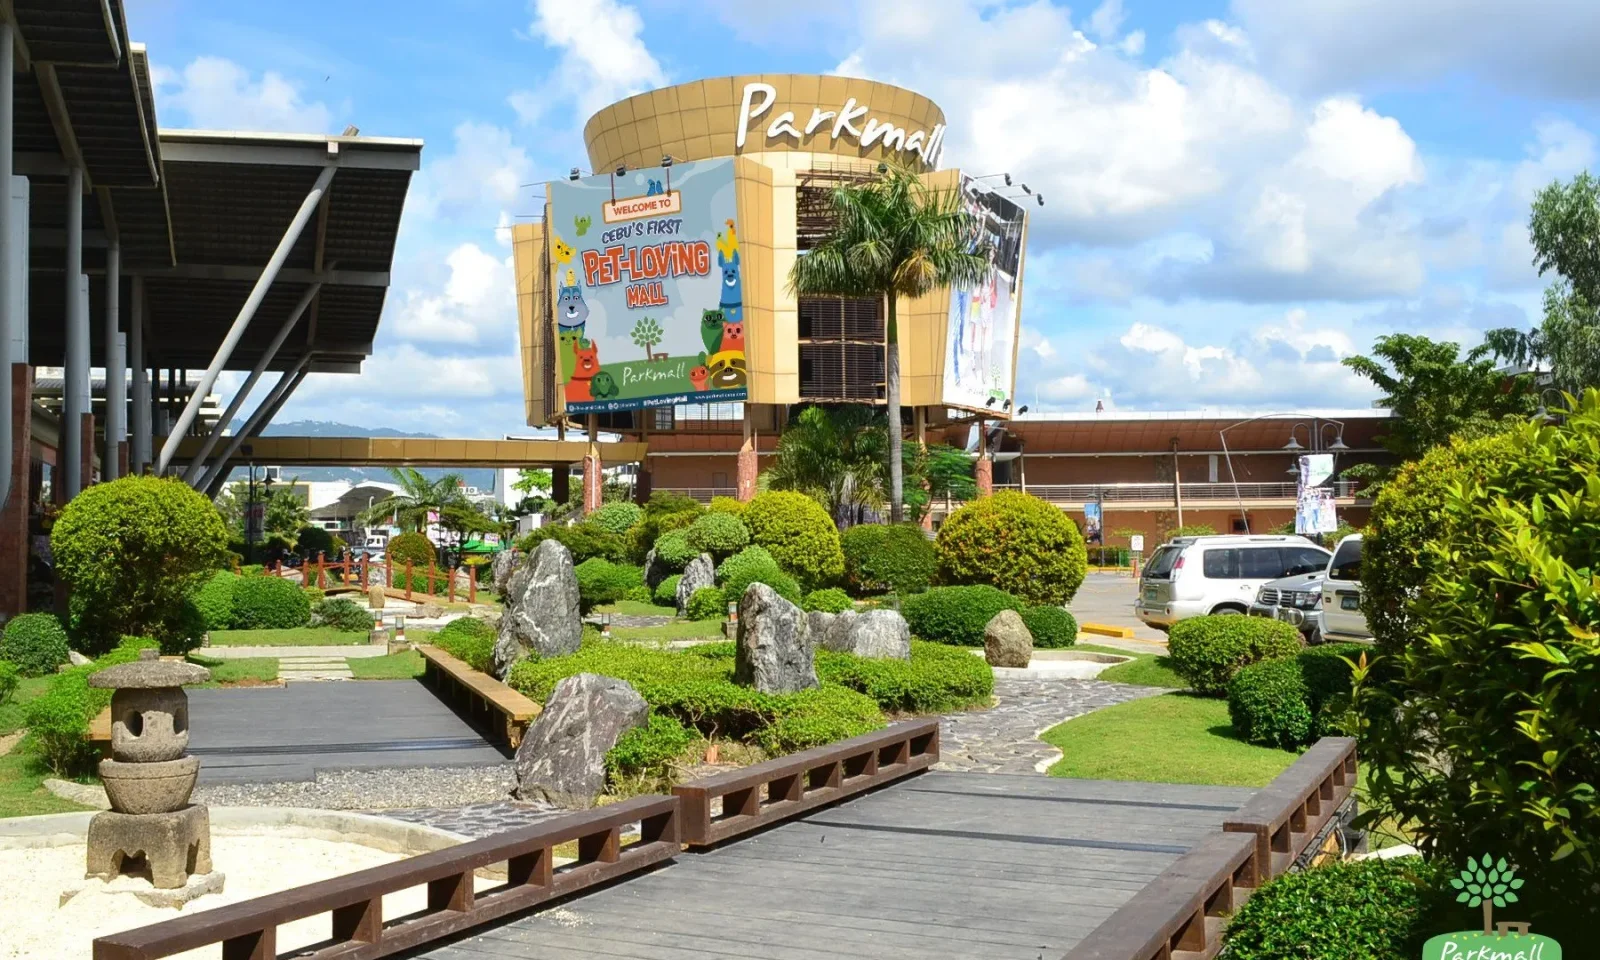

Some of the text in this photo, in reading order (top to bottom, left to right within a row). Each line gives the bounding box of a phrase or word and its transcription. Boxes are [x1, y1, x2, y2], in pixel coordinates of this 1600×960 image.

[736, 82, 946, 172] Parkmall
[613, 199, 671, 216] WELCOME TO
[601, 219, 682, 244] CEBU'S FIRST
[625, 281, 668, 309] MALL
[623, 362, 685, 386] Parkmall
